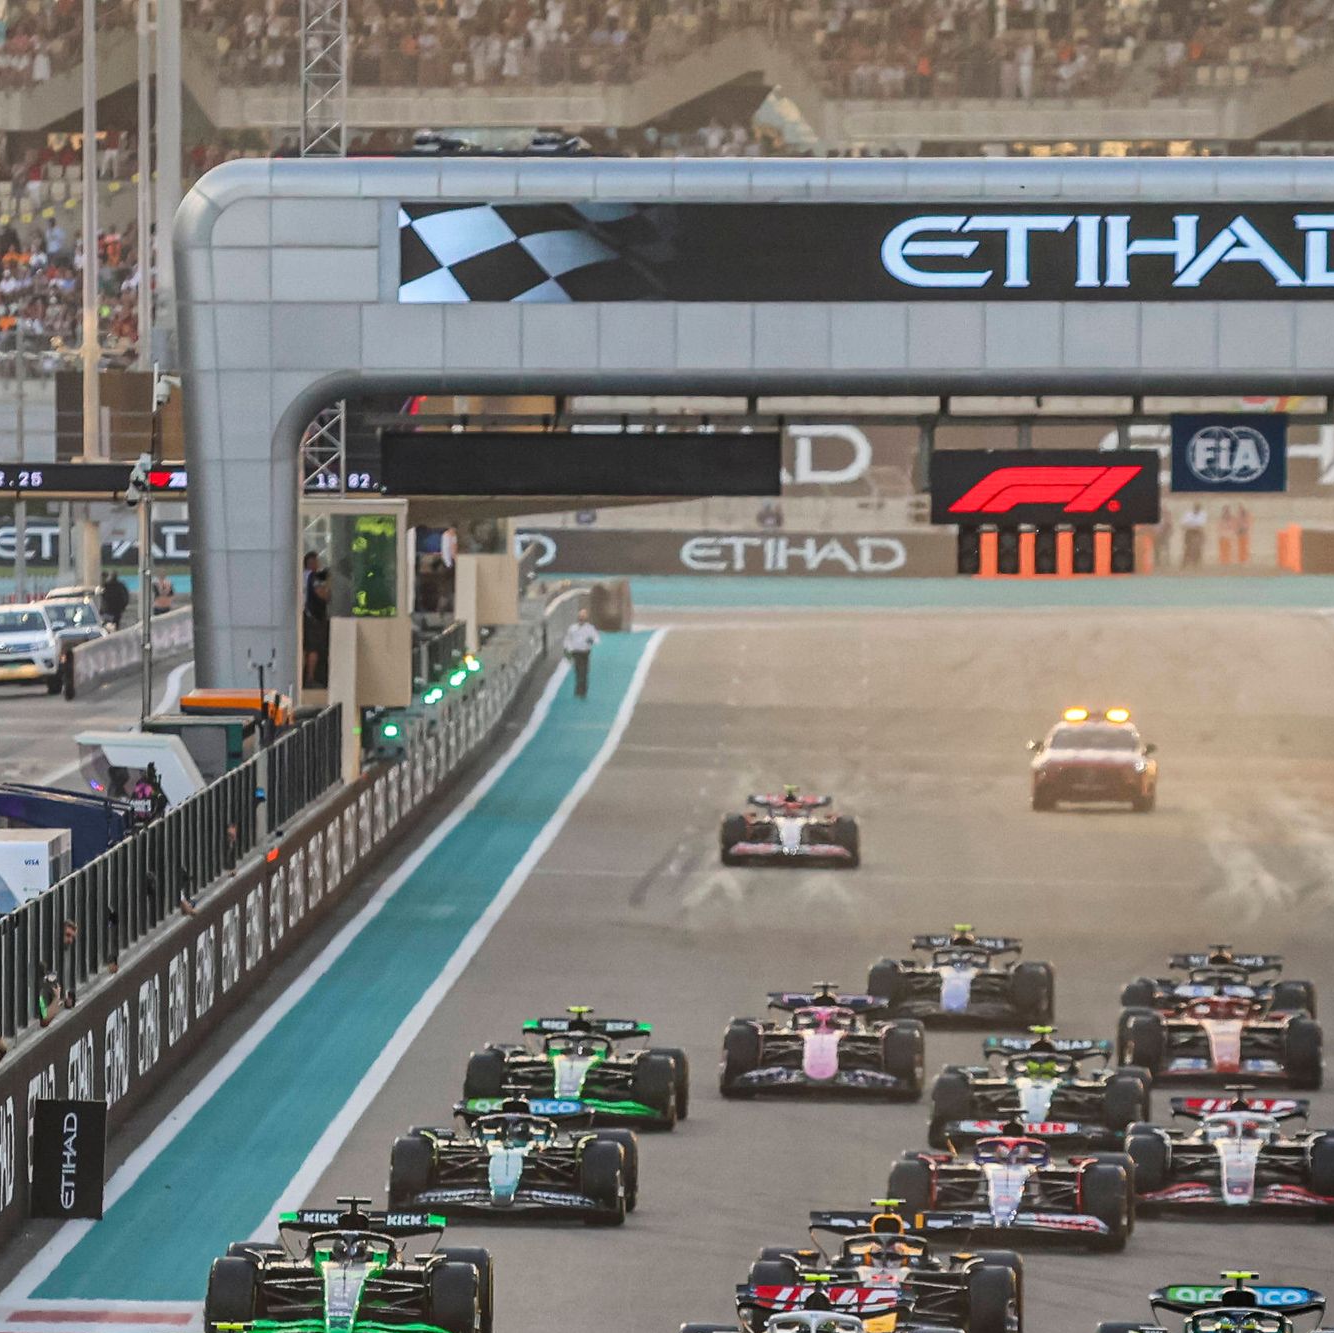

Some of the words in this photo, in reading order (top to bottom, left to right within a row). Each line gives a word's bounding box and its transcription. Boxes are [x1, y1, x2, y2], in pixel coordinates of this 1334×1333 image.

[681, 536, 907, 572] ETIHAD
[60, 1111, 79, 1210] ETIHAD
[304, 1213, 339, 1225] KICK
[386, 1215, 422, 1226] KICK
